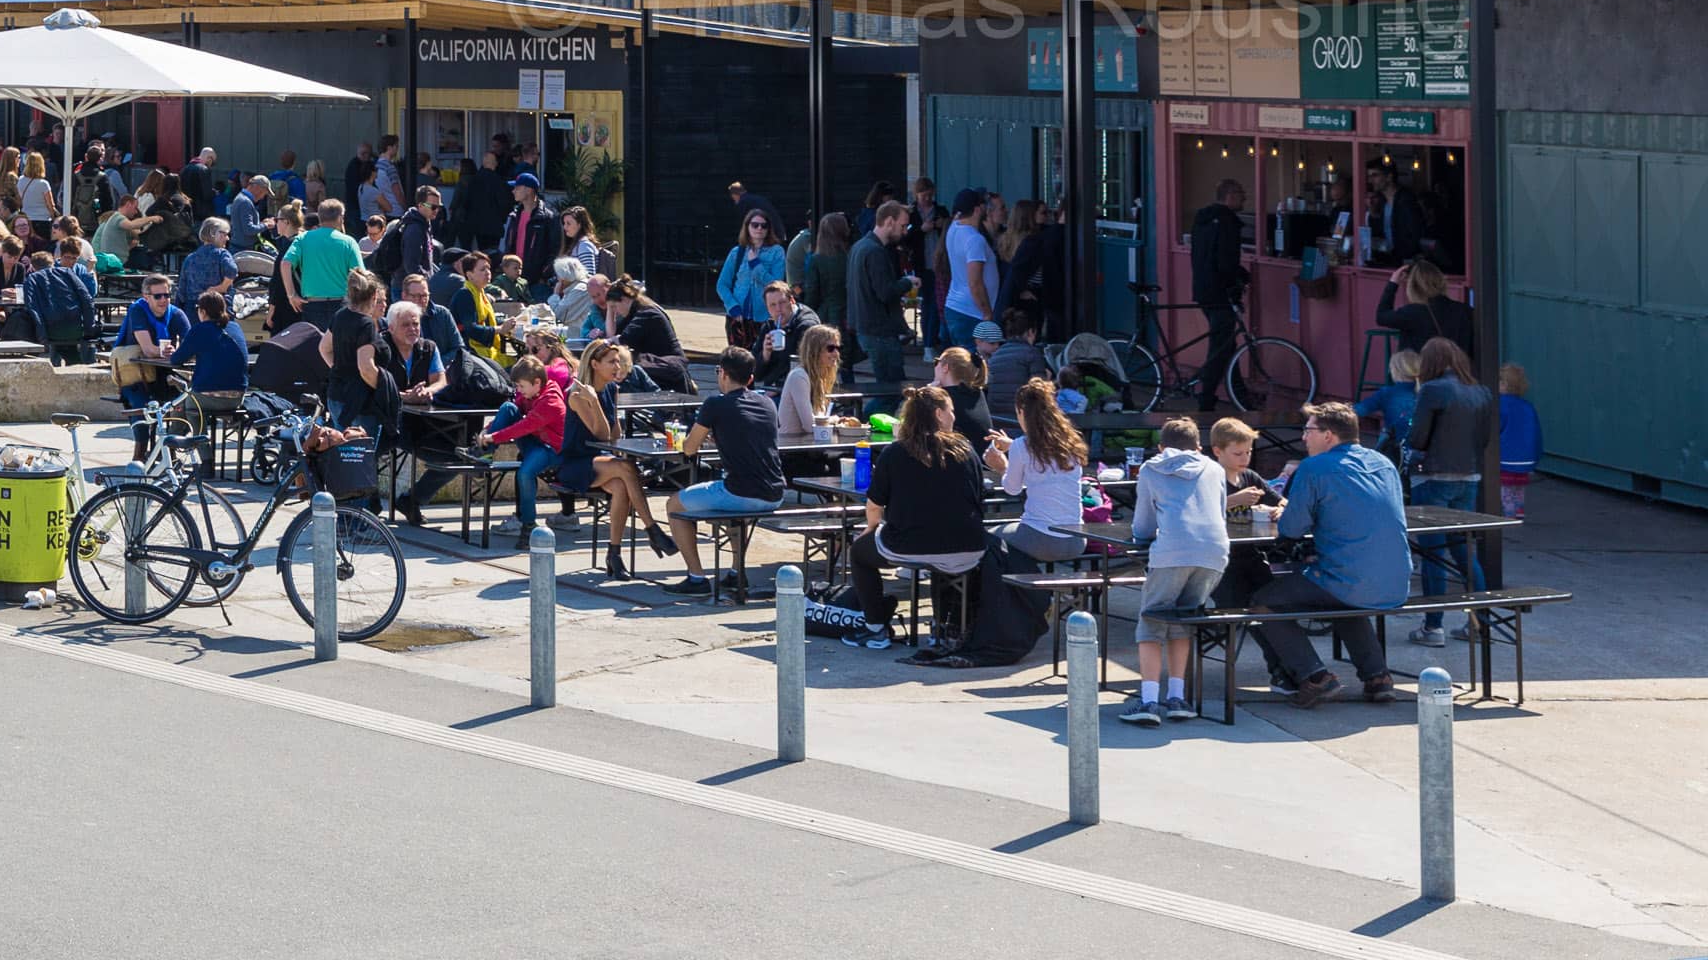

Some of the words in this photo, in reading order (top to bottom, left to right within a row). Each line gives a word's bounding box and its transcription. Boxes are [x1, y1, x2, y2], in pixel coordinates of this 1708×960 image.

[418, 39, 516, 62] CALIFORNIA
[521, 37, 596, 61] KITCHEN
[1313, 36, 1363, 69] GRØD
[1404, 37, 1416, 53] 50
[1404, 72, 1416, 88] 70
[1454, 65, 1465, 79] 80
[805, 607, 867, 628] adidas
